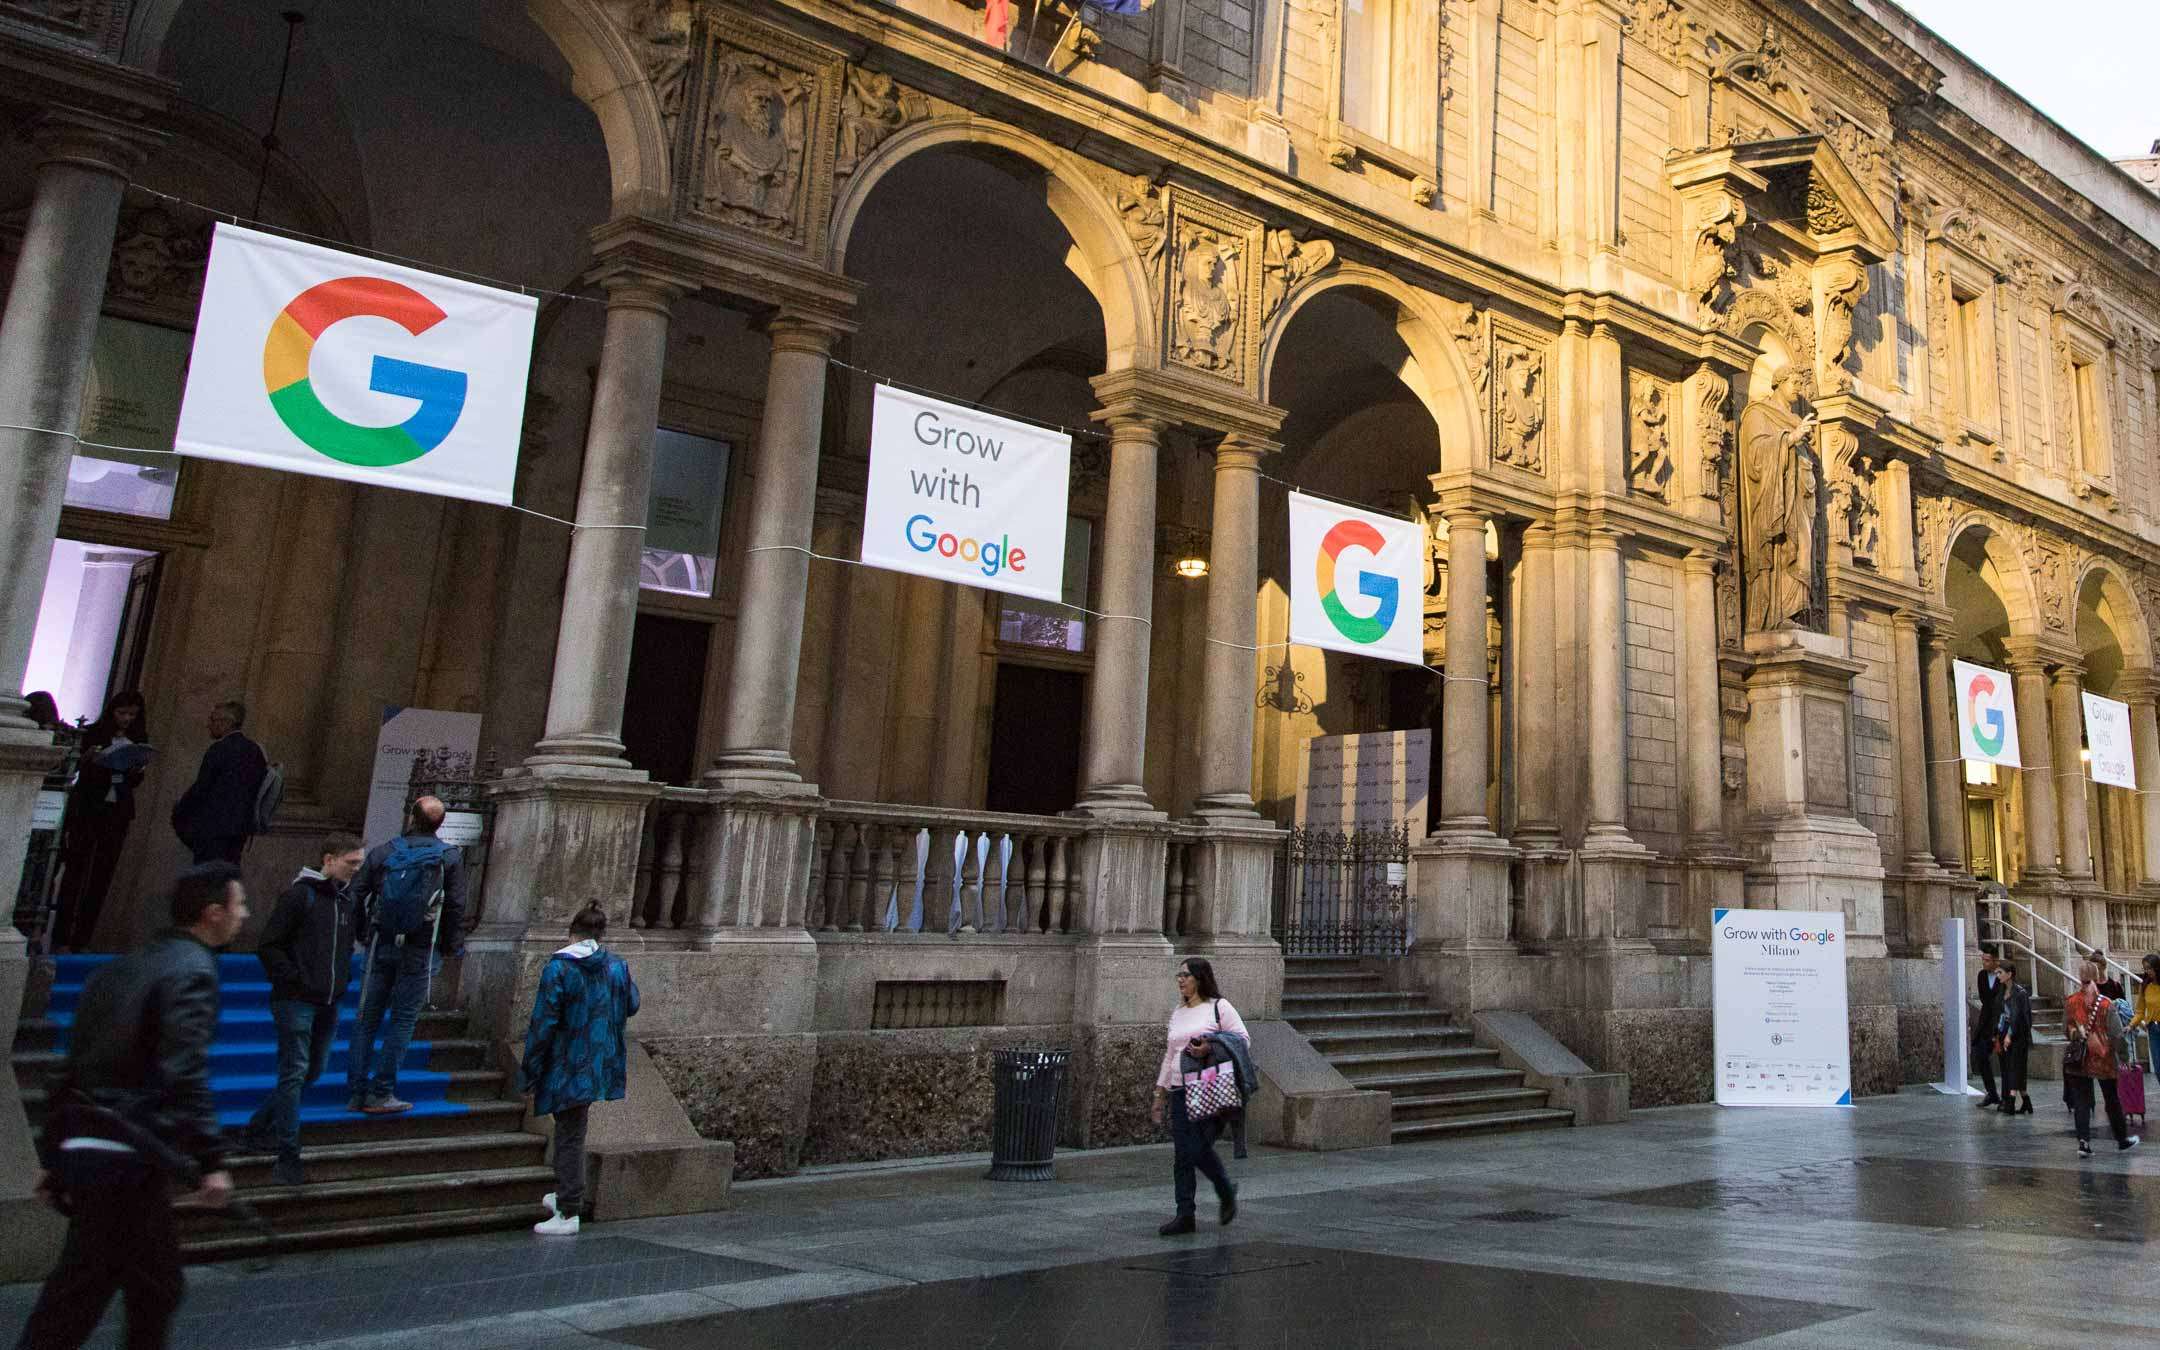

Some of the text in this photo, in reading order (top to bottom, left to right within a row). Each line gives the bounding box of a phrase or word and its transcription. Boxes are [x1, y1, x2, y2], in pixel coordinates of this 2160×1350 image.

[263, 276, 467, 467] G
[914, 411, 1004, 462] Grow
[910, 467, 981, 509] with
[905, 514, 1026, 577] Google
[1316, 519, 1399, 644] G
[1968, 673, 2005, 757] G
[2092, 702, 2114, 722] Grow
[1724, 926, 1835, 945] Grow with Google
[1761, 944, 1800, 957] Milano
